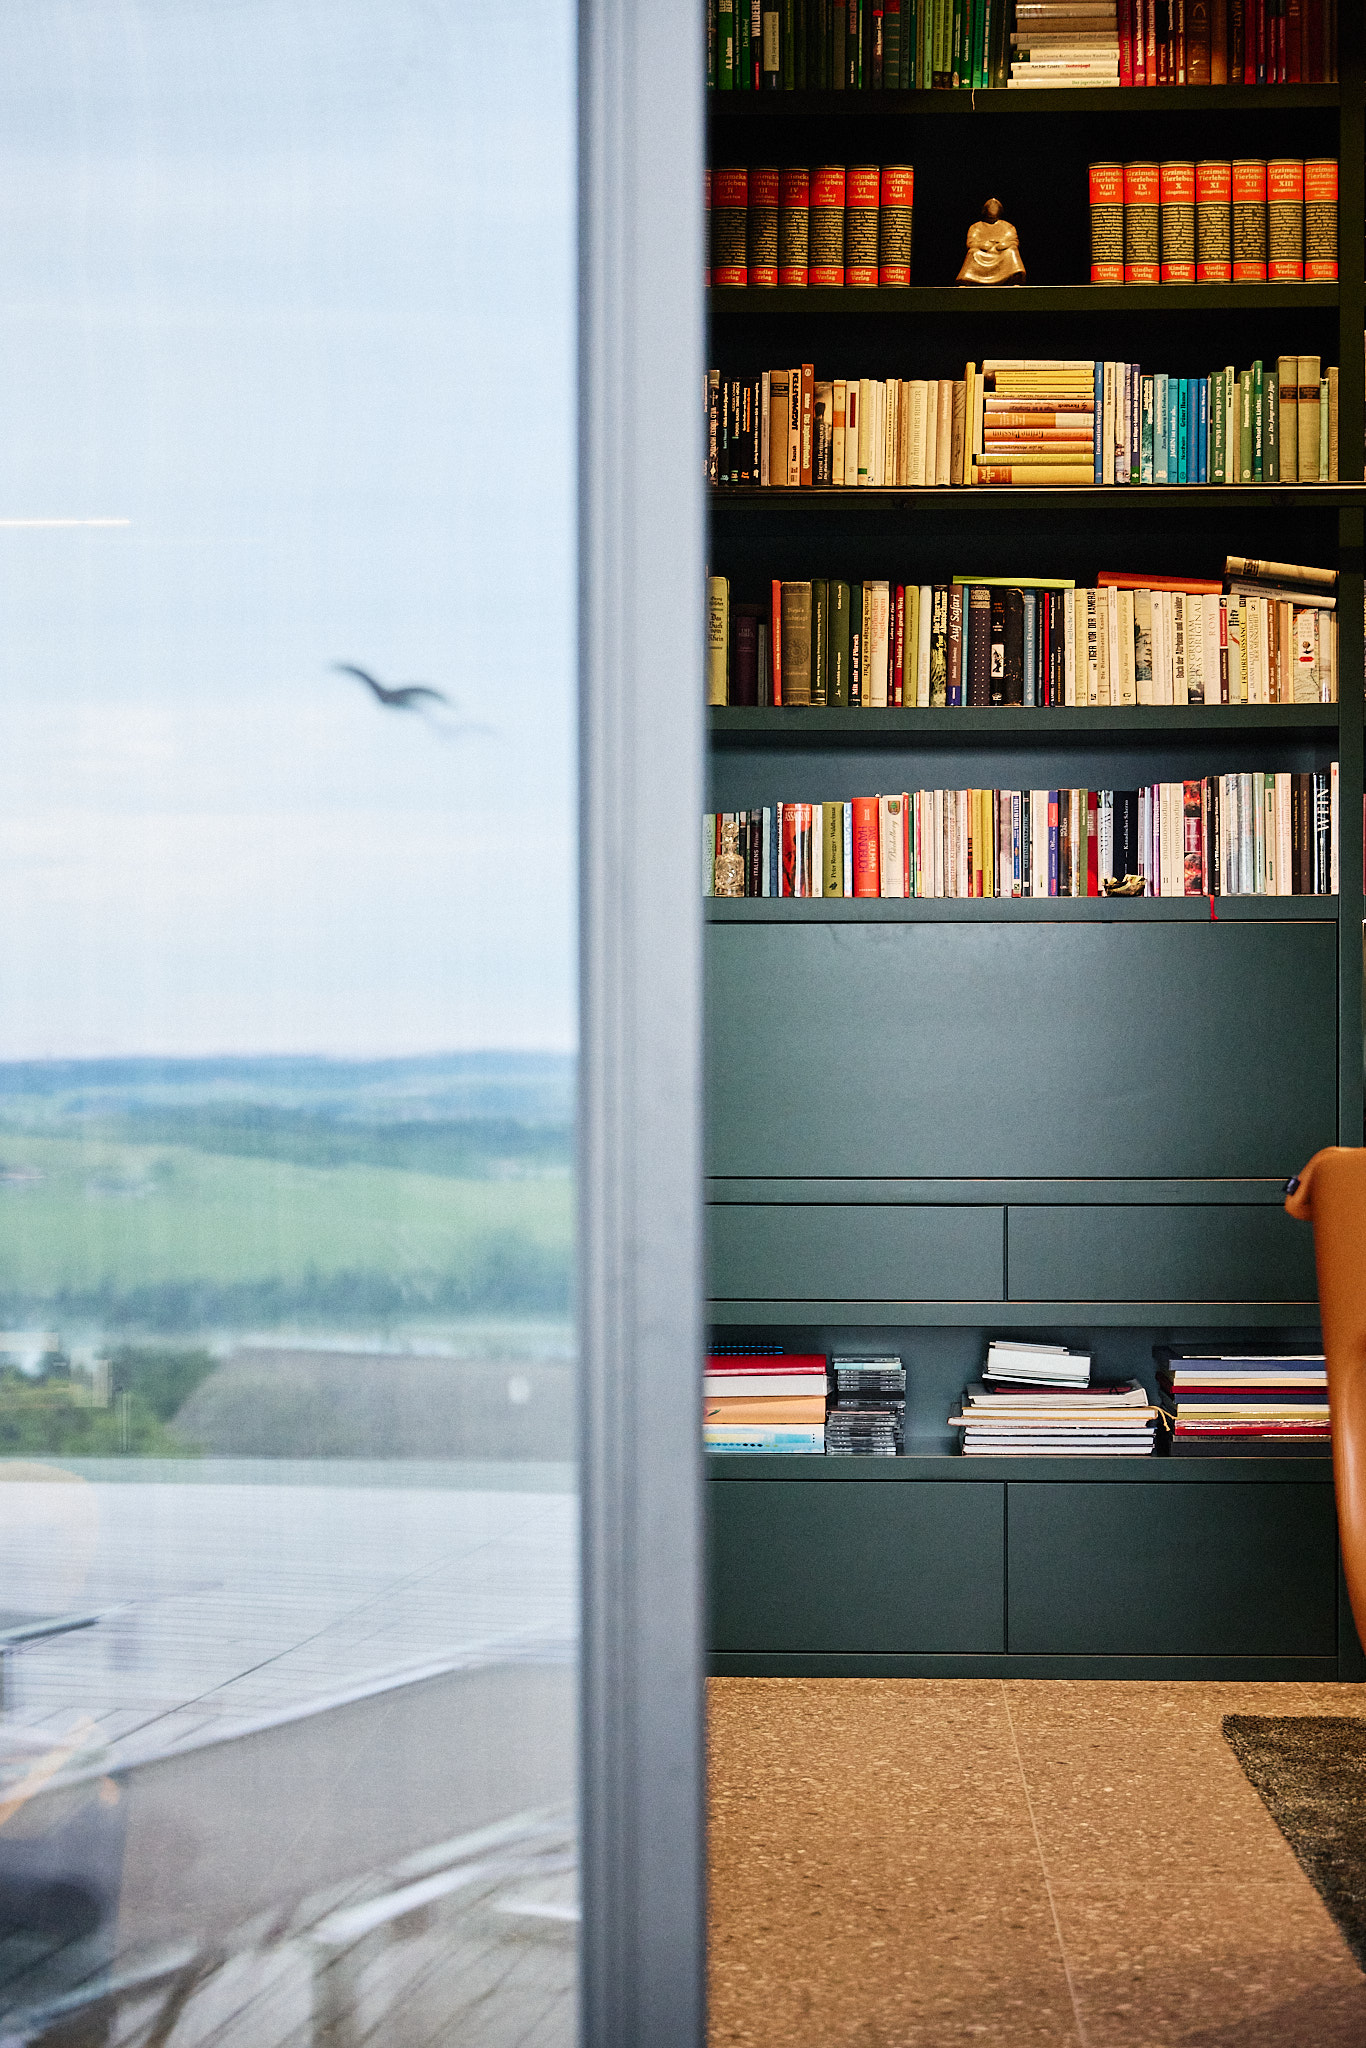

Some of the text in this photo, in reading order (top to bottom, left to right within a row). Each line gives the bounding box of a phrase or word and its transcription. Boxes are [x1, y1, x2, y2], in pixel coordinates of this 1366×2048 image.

[791, 372, 799, 431] JAGDWAFFEN
[1255, 449, 1261, 457] Im
[950, 594, 962, 642] Auf Safari
[1088, 591, 1097, 661] TIGER VOR DER KAMERA
[1175, 622, 1184, 631] und
[1175, 656, 1184, 664] der
[1175, 666, 1184, 678] Buch
[1317, 788, 1329, 831] WEIN
[868, 826, 876, 839] DAS
[858, 826, 868, 873] HANDBUCH
